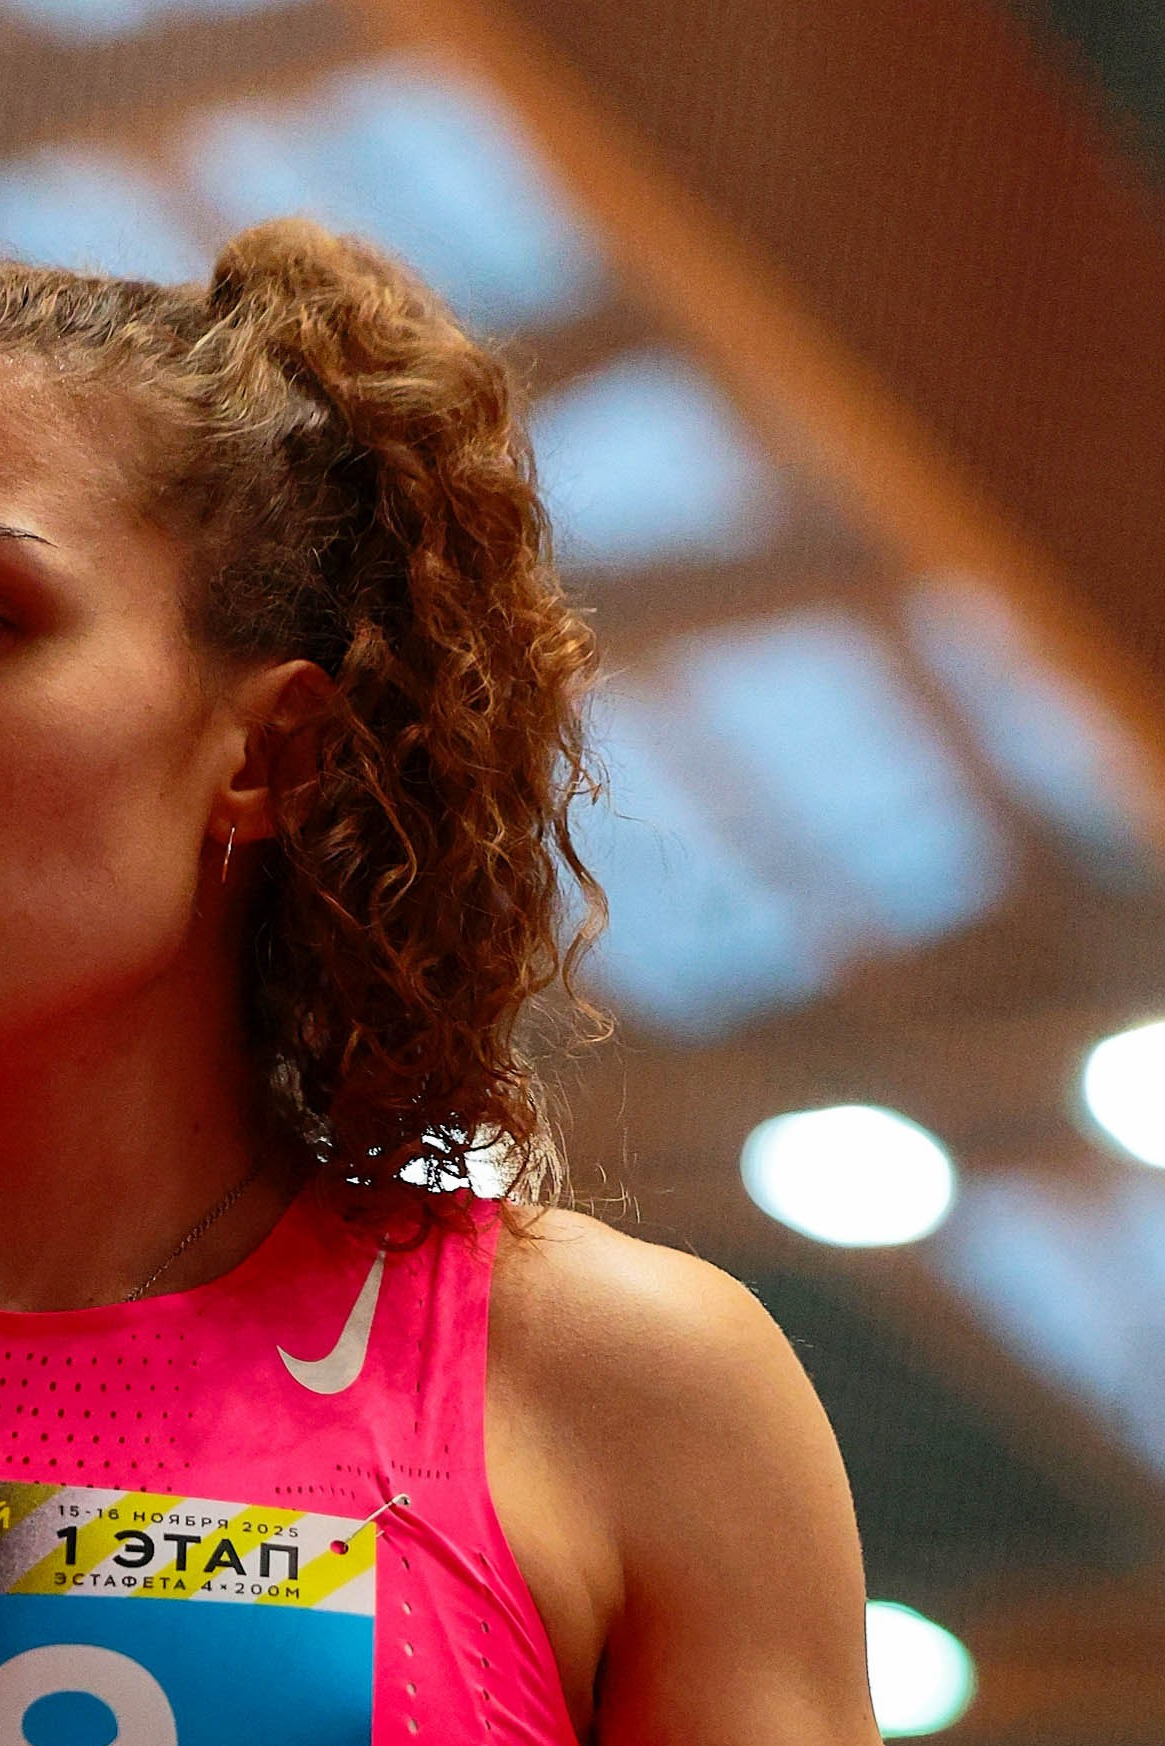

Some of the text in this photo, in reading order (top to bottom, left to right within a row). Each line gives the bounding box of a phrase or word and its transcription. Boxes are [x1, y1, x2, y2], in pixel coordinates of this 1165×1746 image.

[133, 1511, 230, 1530] НОЯБРЯ
[242, 1521, 299, 1538] 2025
[56, 1526, 300, 1581] 1 ЭТАП
[53, 1572, 187, 1591] ЭСТАФЕТА
